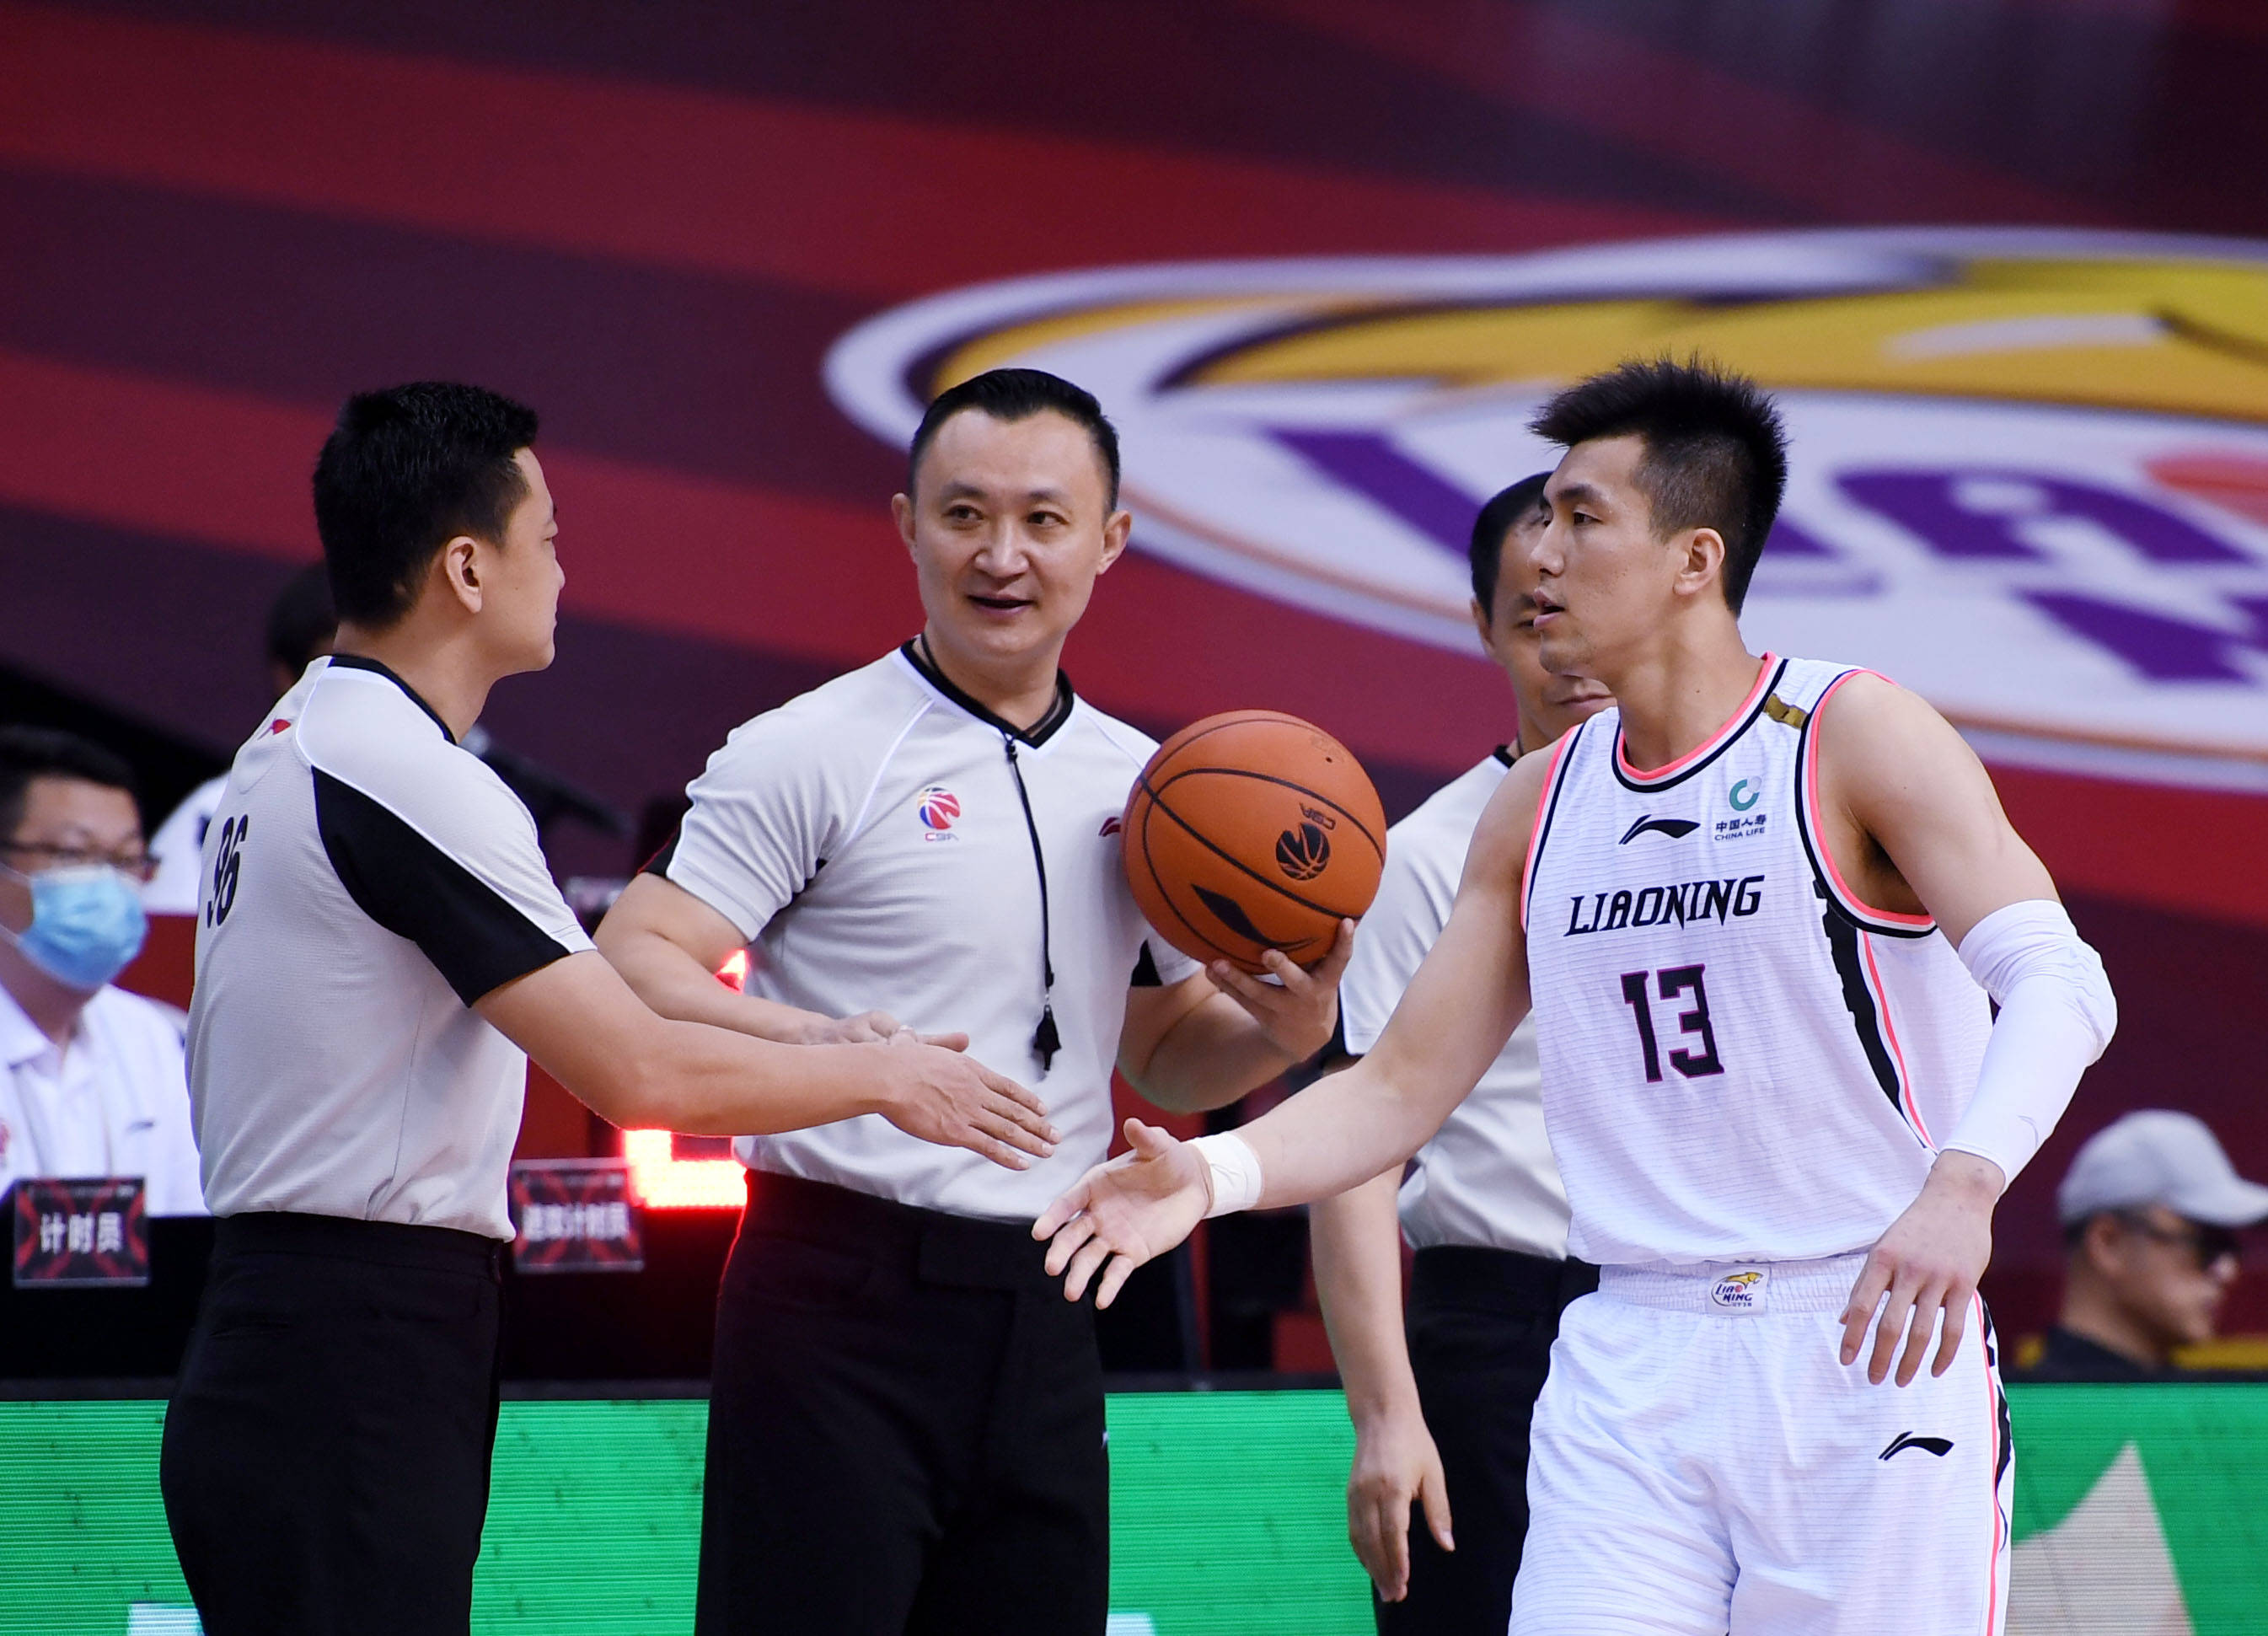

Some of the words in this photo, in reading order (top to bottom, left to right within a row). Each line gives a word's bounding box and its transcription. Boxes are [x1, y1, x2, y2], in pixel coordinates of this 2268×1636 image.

[1714, 831, 1743, 841] CHINA
[1746, 827, 1765, 836] LIFE
[1715, 814, 1767, 833] 中国人寿
[1563, 874, 1766, 937] LIAONING
[1620, 963, 1725, 1084] 13
[40, 1211, 122, 1255] 计时员
[1723, 1292, 1753, 1303] NING
